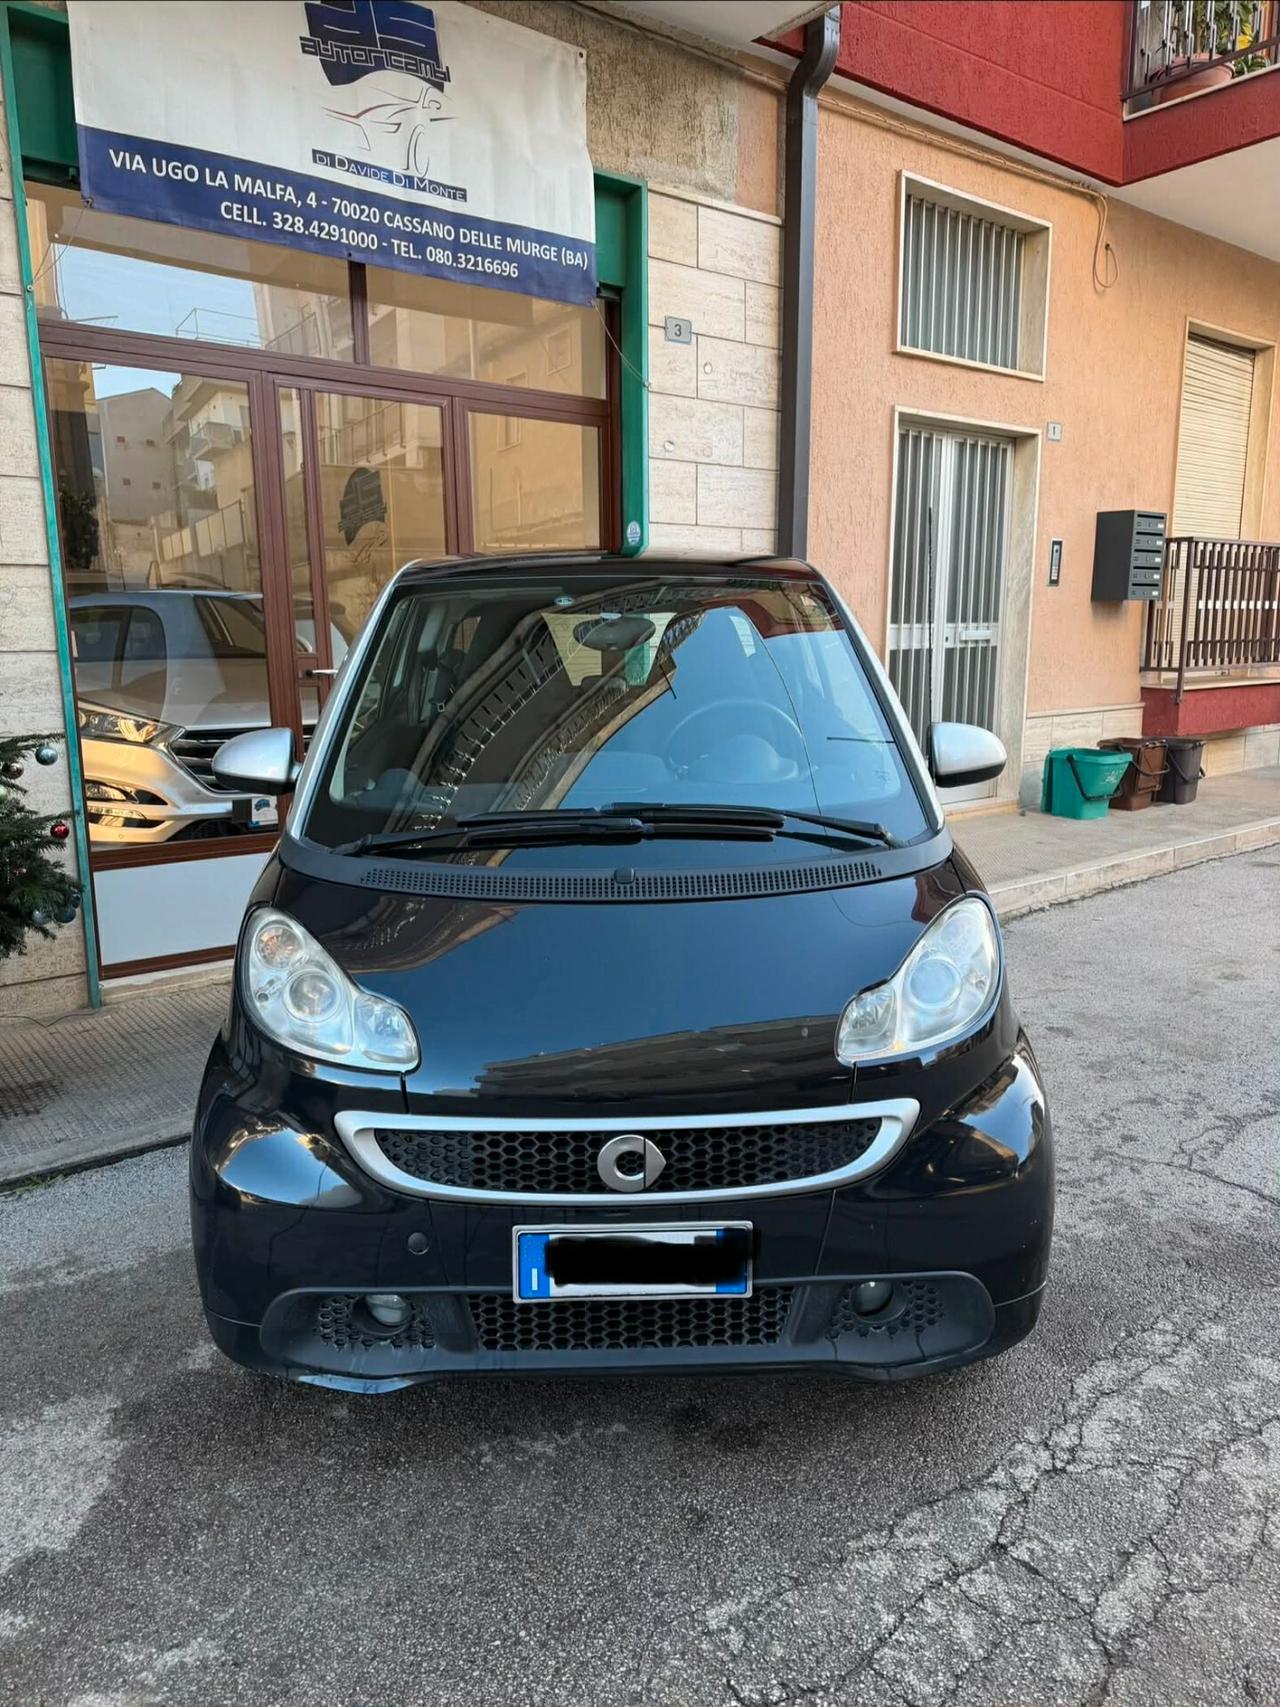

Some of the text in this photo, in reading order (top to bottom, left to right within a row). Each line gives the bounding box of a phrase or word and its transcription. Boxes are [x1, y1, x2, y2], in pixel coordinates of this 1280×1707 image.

[109, 150, 147, 175] VIA
[152, 159, 199, 183] UGO
[205, 169, 229, 189] LA
[233, 175, 303, 208] MALFA,
[306, 191, 318, 208] 4
[331, 197, 380, 225] 70020
[384, 210, 455, 241] CASSANO
[459, 228, 502, 249] DELLE
[506, 238, 559, 262] MURGE
[561, 249, 589, 270] (BA)
[220, 201, 267, 227] CELL.
[272, 211, 378, 250] 328.4291000
[391, 239, 422, 260] TEL.
[426, 247, 519, 278] 080.3216696
[674, 324, 682, 337] 3
